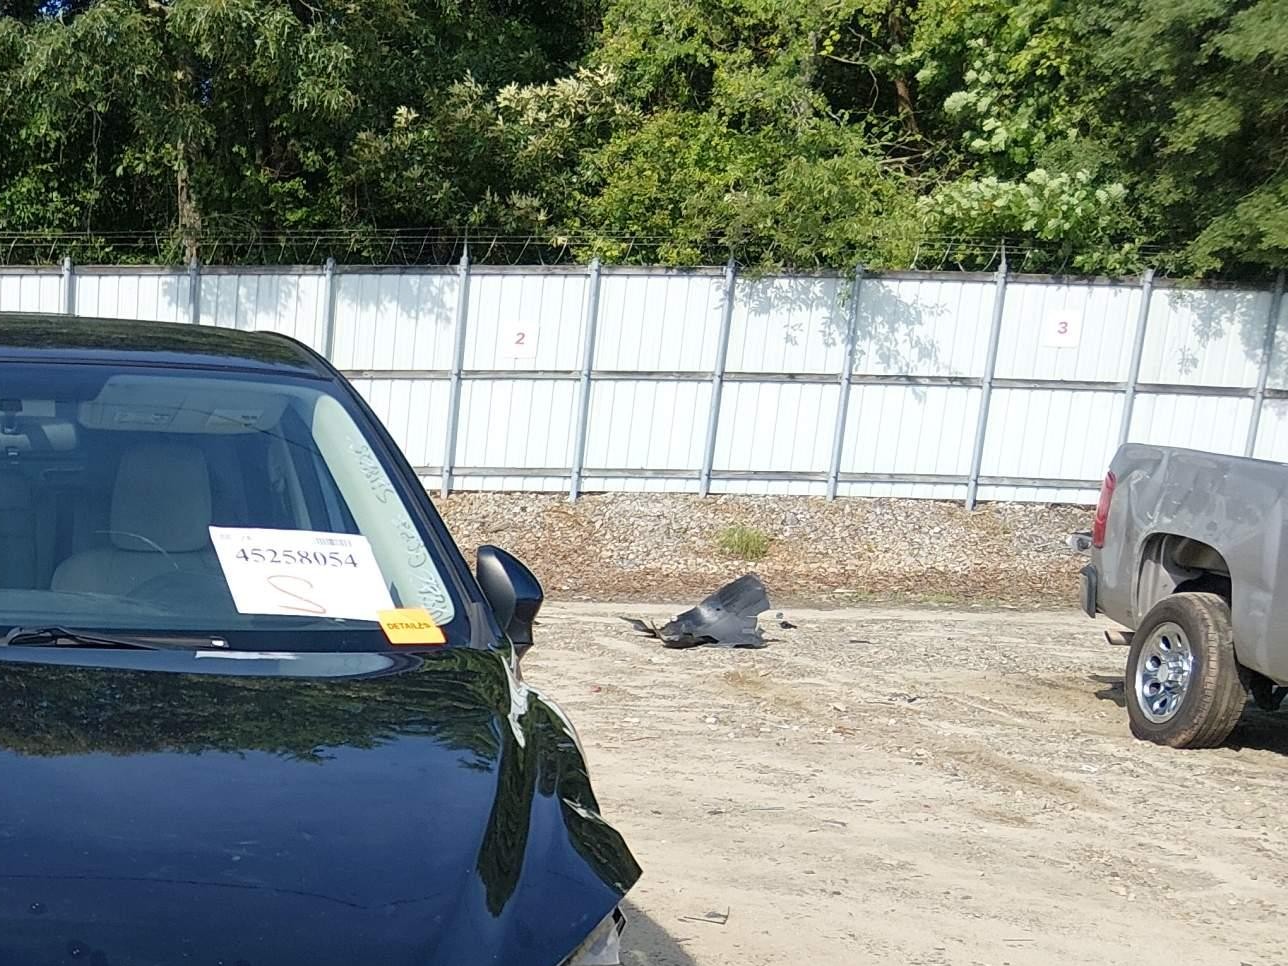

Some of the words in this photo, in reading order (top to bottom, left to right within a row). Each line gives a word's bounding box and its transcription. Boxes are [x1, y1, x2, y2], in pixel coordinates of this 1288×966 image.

[1057, 321, 1068, 334] 3
[514, 332, 526, 345] 2
[235, 547, 359, 568] 45258054
